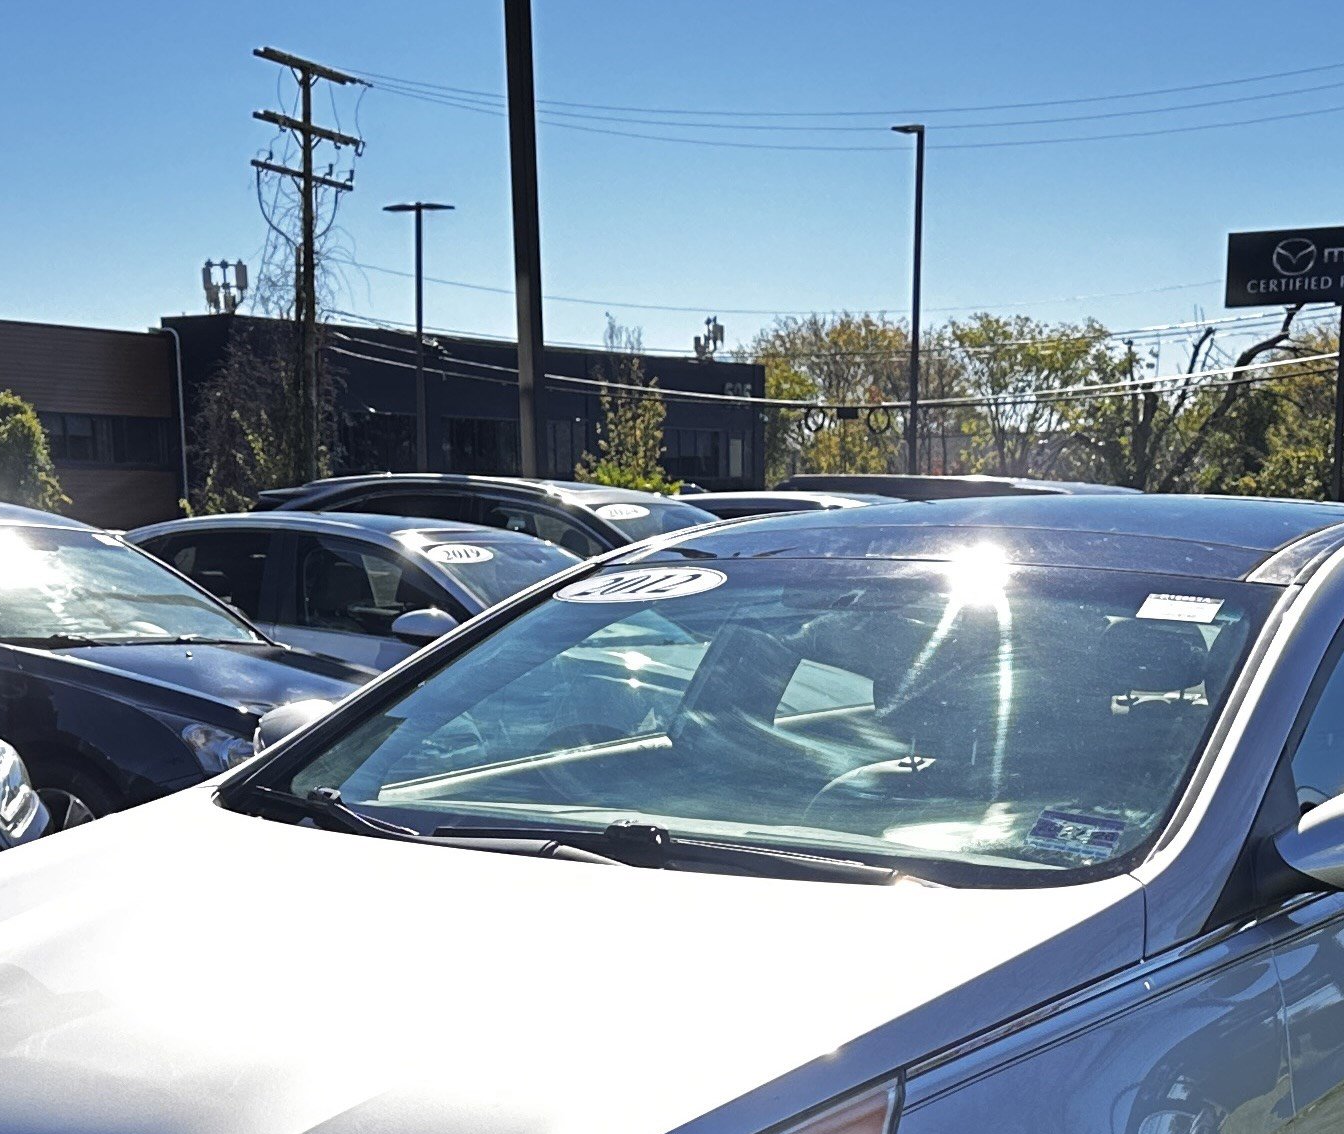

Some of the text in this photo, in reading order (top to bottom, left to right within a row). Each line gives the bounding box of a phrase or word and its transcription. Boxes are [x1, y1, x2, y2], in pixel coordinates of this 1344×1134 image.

[1246, 275, 1332, 294] CERTIFIED
[445, 547, 481, 561] 2019
[574, 573, 702, 597] 2012
